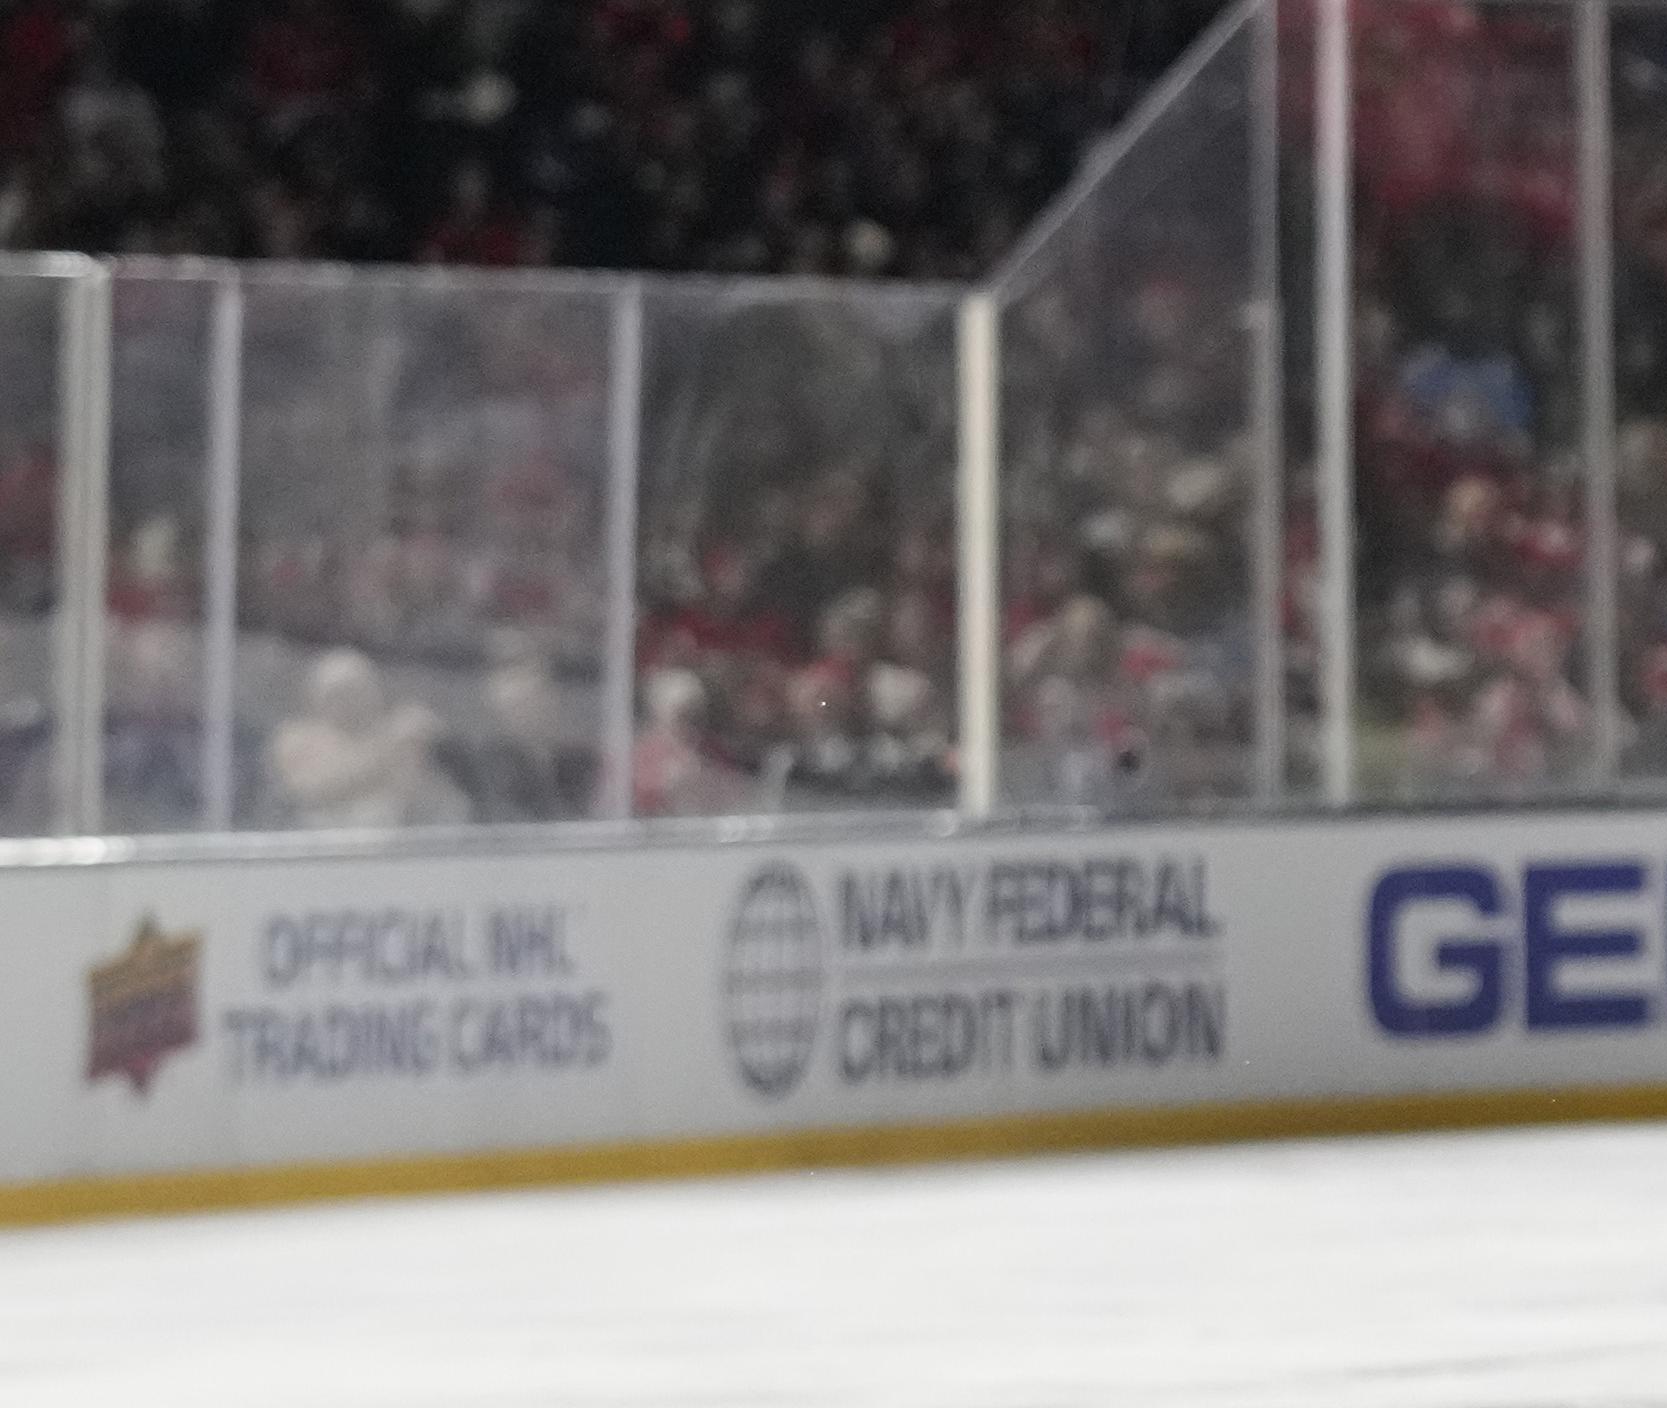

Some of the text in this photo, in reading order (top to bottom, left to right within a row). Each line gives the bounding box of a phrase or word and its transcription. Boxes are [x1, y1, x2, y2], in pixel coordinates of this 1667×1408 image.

[263, 908, 476, 988] OFFICIAL
[840, 858, 1225, 948] NAVY FEDERAL
[222, 994, 616, 1085] TRADING CARDS
[842, 982, 1228, 1085] CREDIT UNION
